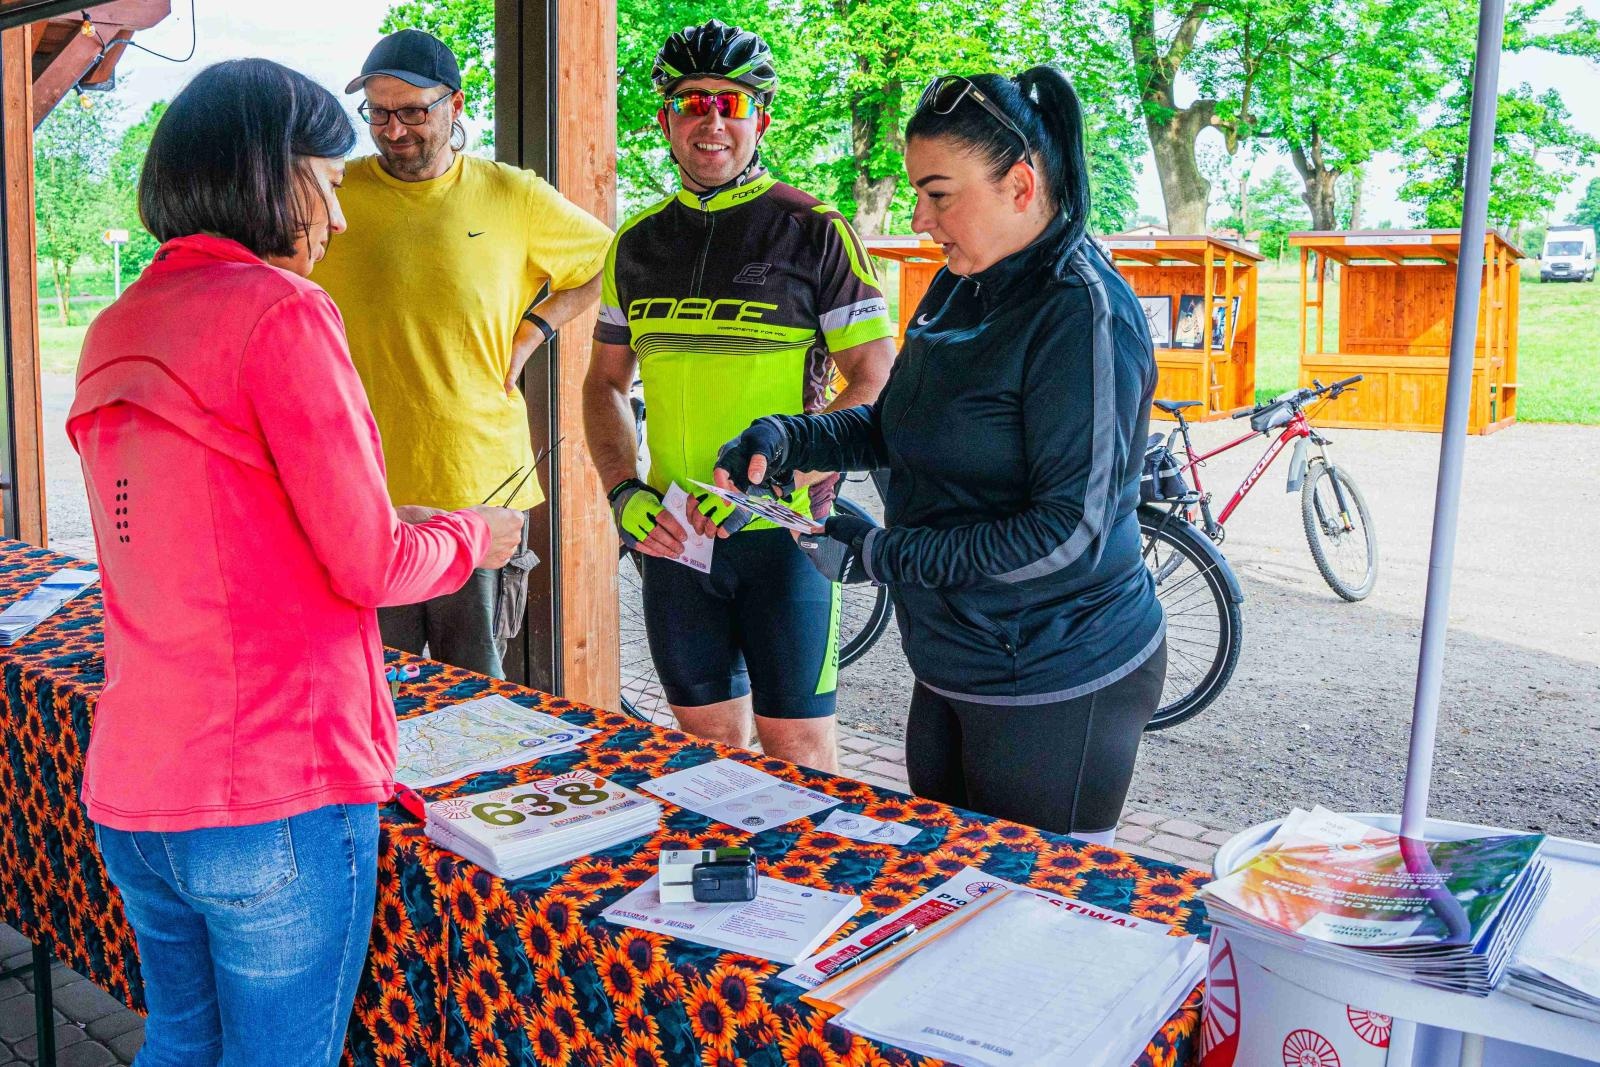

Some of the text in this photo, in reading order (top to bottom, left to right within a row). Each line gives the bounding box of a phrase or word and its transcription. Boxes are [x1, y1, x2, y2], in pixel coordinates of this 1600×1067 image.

[732, 183, 764, 200] FORCE
[628, 298, 778, 322] FORCE
[849, 304, 878, 319] FORCE
[1239, 438, 1284, 496] KROSS
[471, 782, 610, 826] 638
